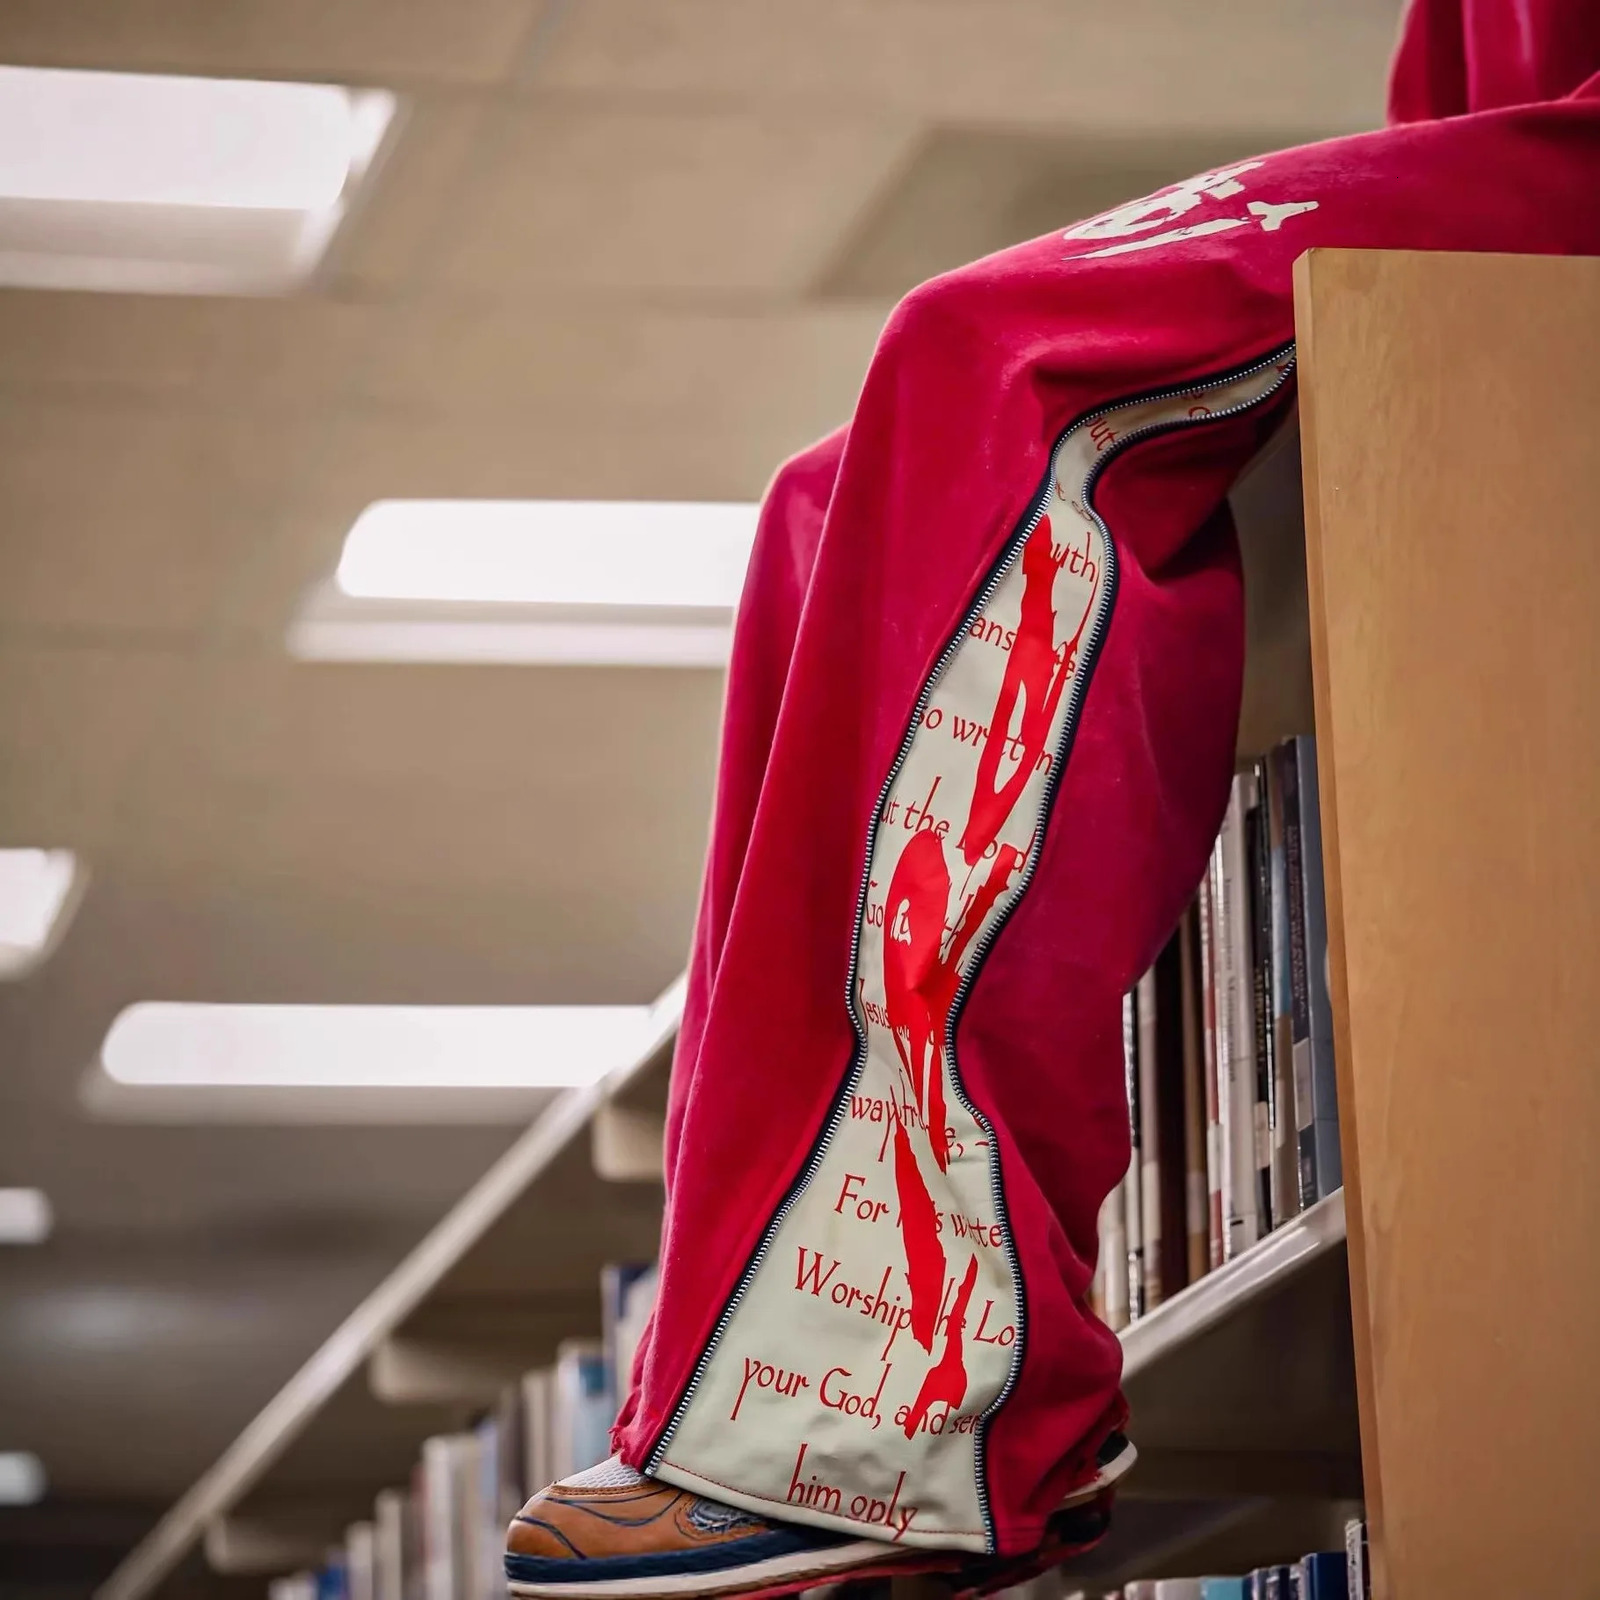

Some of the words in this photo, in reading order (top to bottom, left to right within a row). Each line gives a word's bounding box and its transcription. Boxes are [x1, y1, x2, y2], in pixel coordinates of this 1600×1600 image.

[904, 775, 950, 842] the
[834, 1173, 890, 1223] For
[794, 1246, 912, 1362] Worship
[729, 1357, 811, 1422] your
[819, 1362, 890, 1430] God,
[786, 1443, 842, 1513] him
